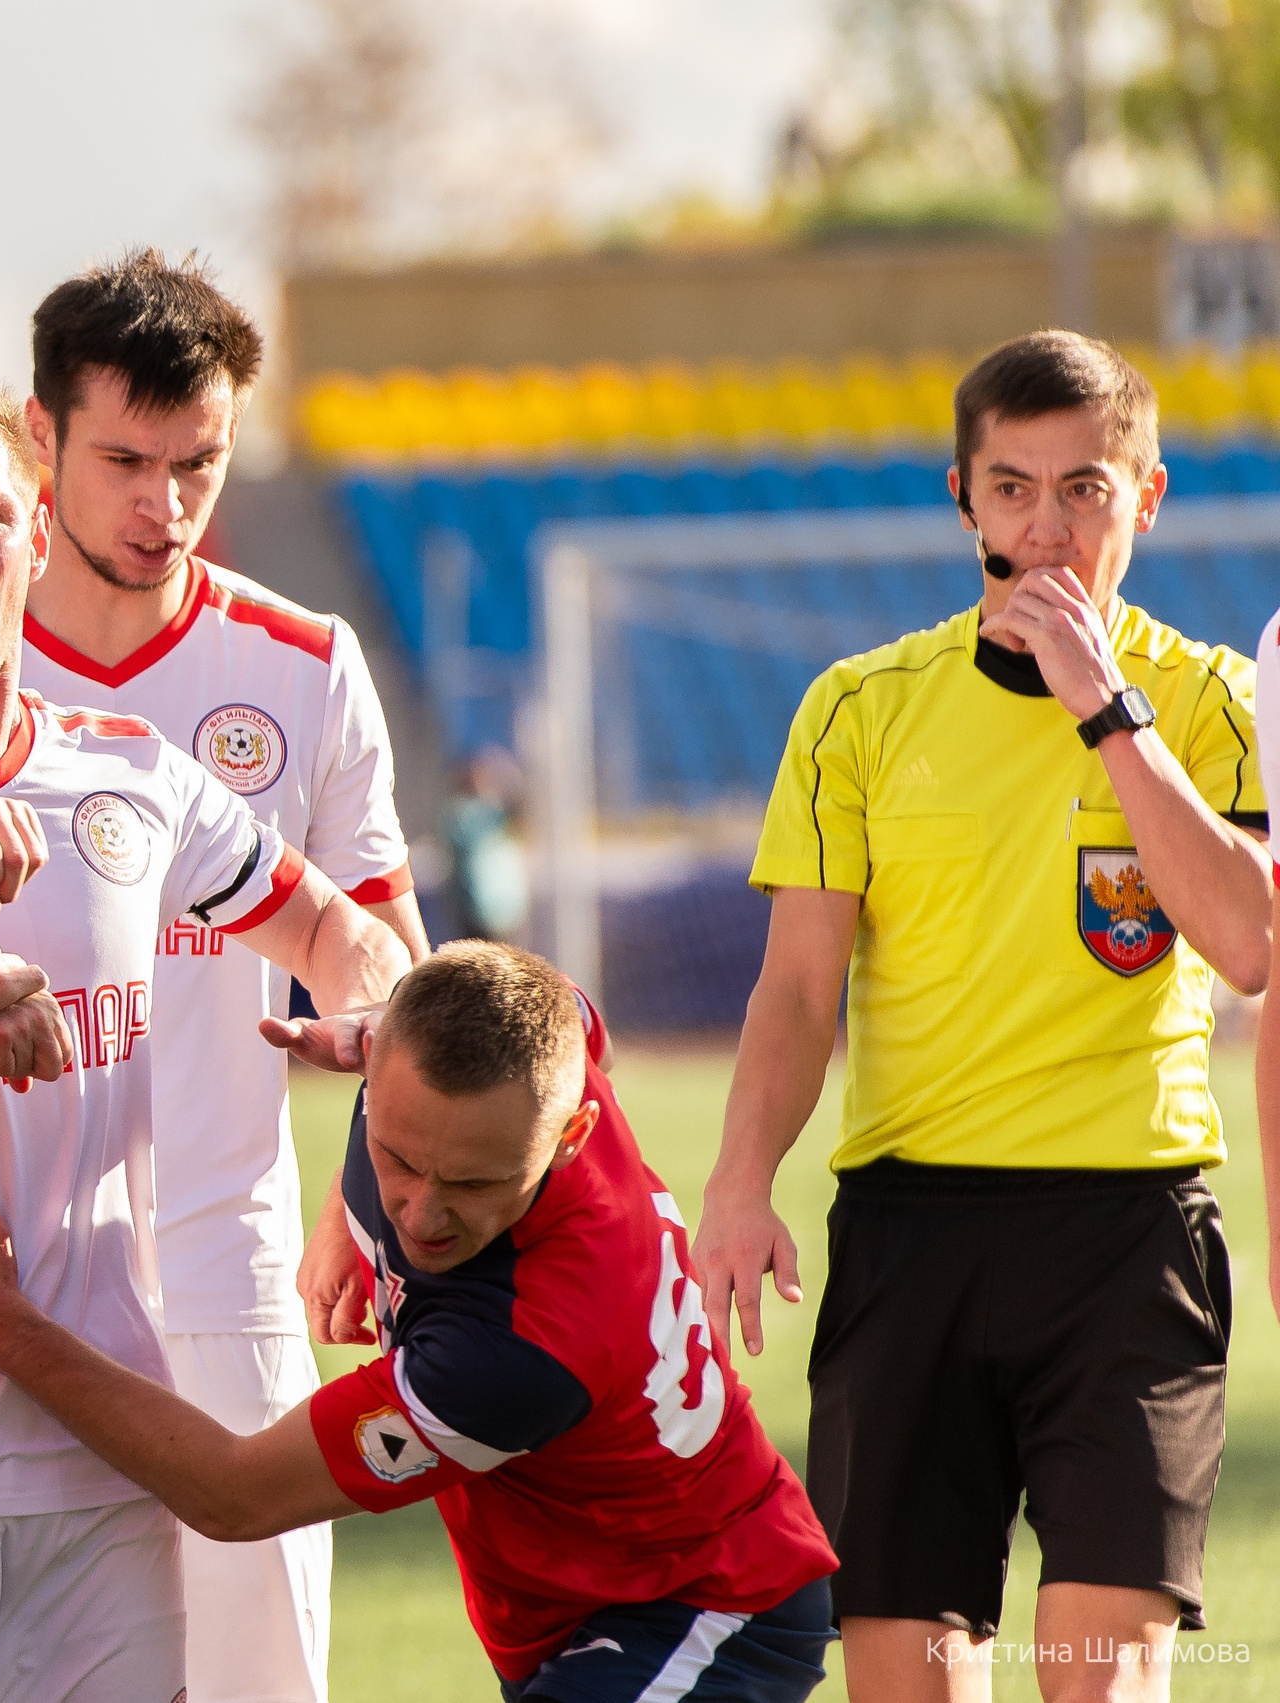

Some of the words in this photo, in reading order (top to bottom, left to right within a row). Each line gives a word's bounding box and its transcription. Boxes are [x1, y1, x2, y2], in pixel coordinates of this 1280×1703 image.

[209, 716, 224, 728] ФК
[225, 710, 268, 728] ИЛЬПАР
[643, 1191, 726, 1458] 6
